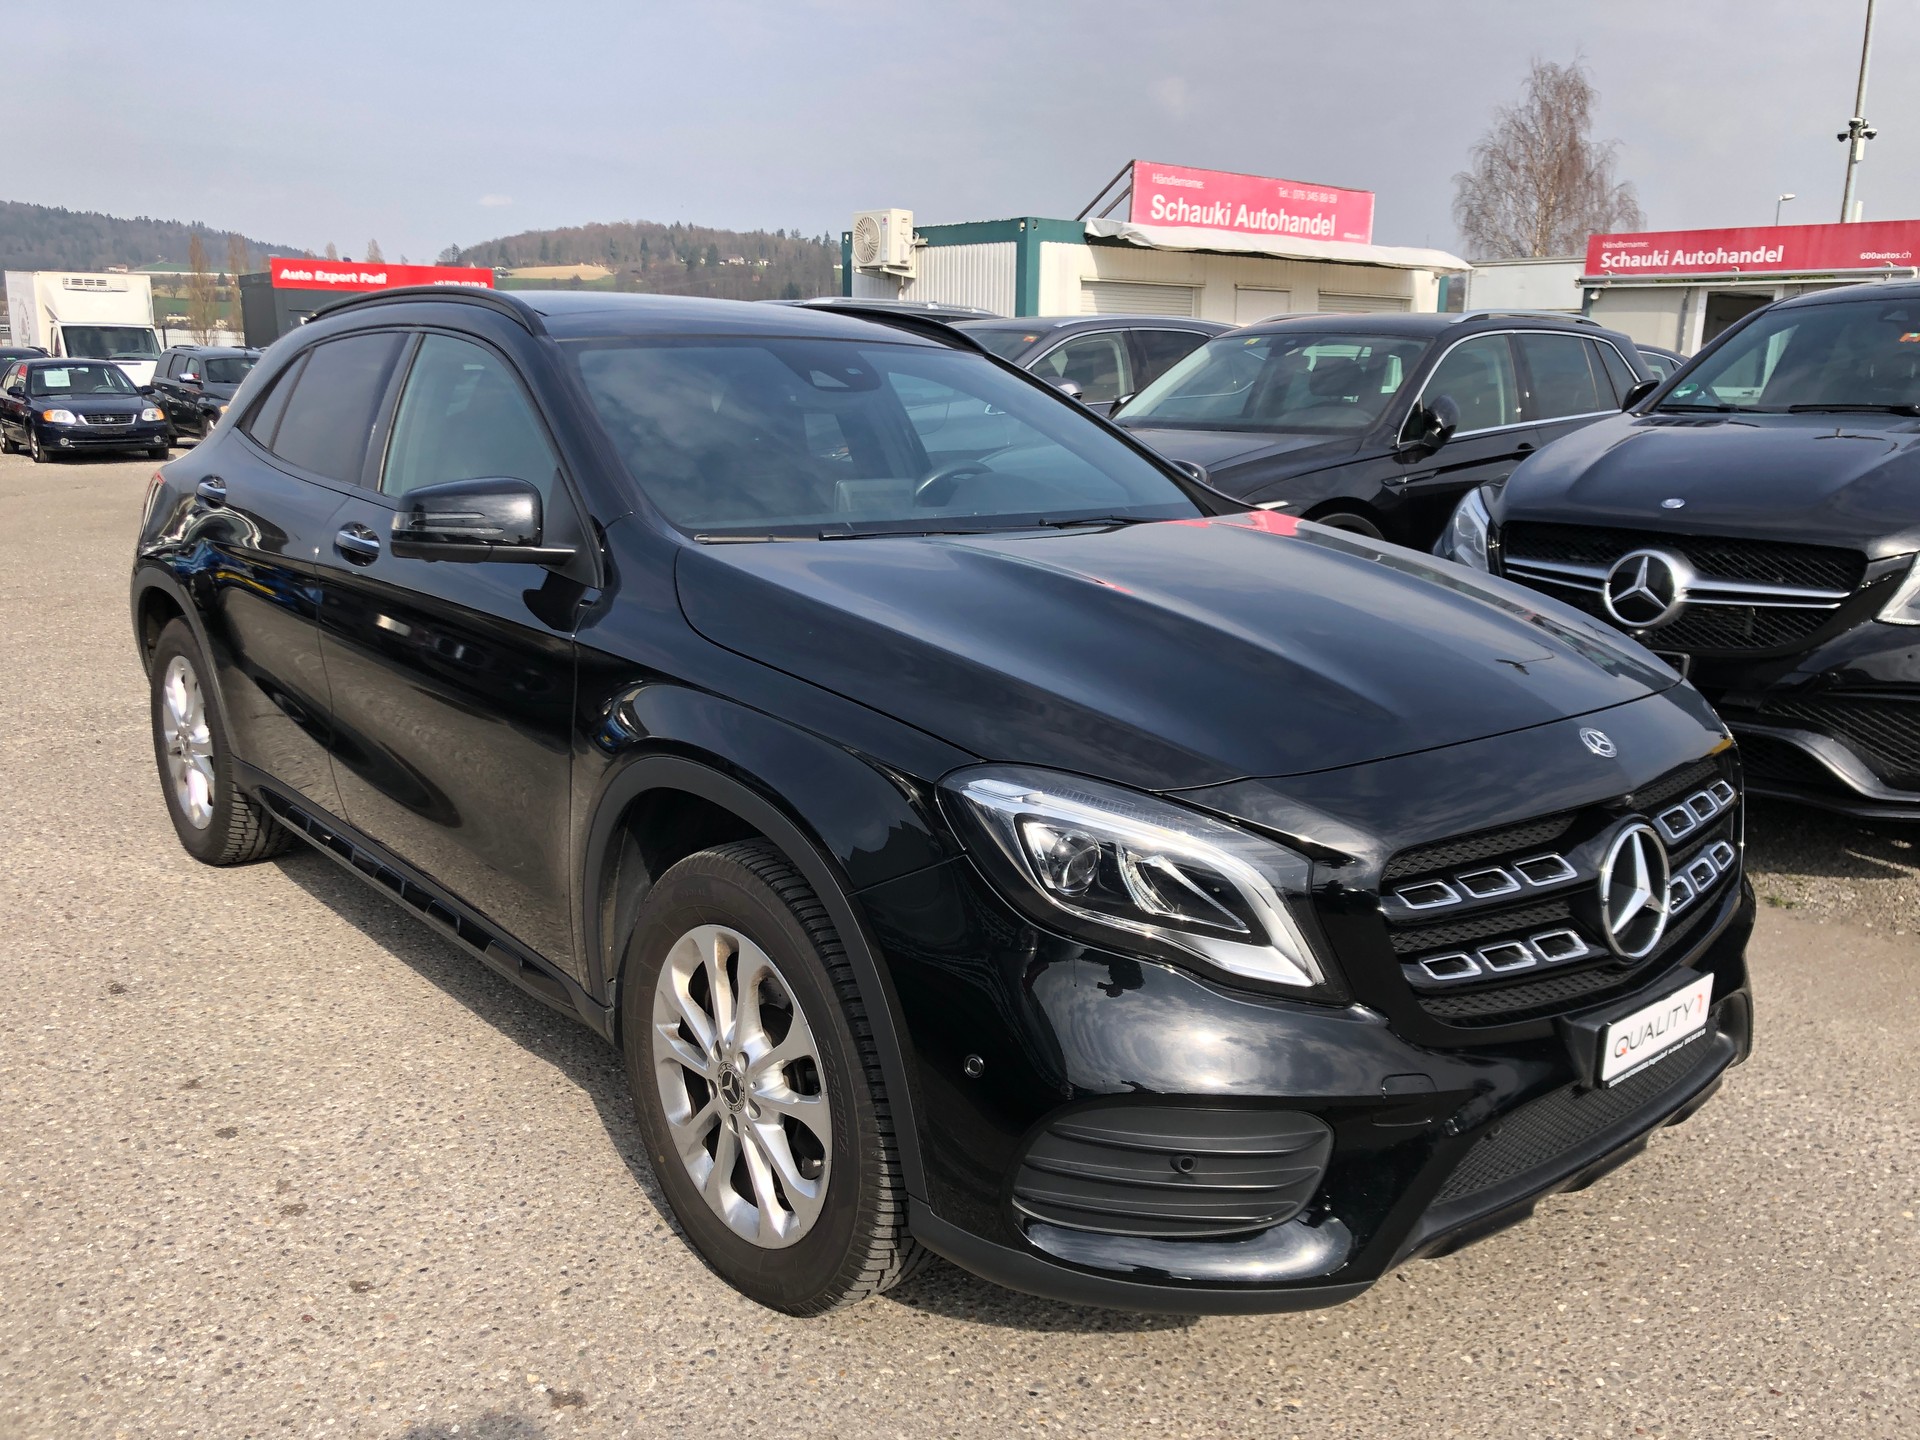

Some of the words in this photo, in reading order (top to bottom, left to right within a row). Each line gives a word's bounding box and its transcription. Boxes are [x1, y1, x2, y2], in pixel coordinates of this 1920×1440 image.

[1151, 193, 1232, 226] Schauki
[1235, 204, 1336, 236] Autohandel
[1600, 249, 1669, 268] Schauki
[1671, 245, 1784, 266] Autohandel
[1860, 250, 1912, 260] 600autos.ch
[280, 269, 313, 281] Auto
[314, 270, 359, 284] Export
[360, 274, 387, 285] Fadi
